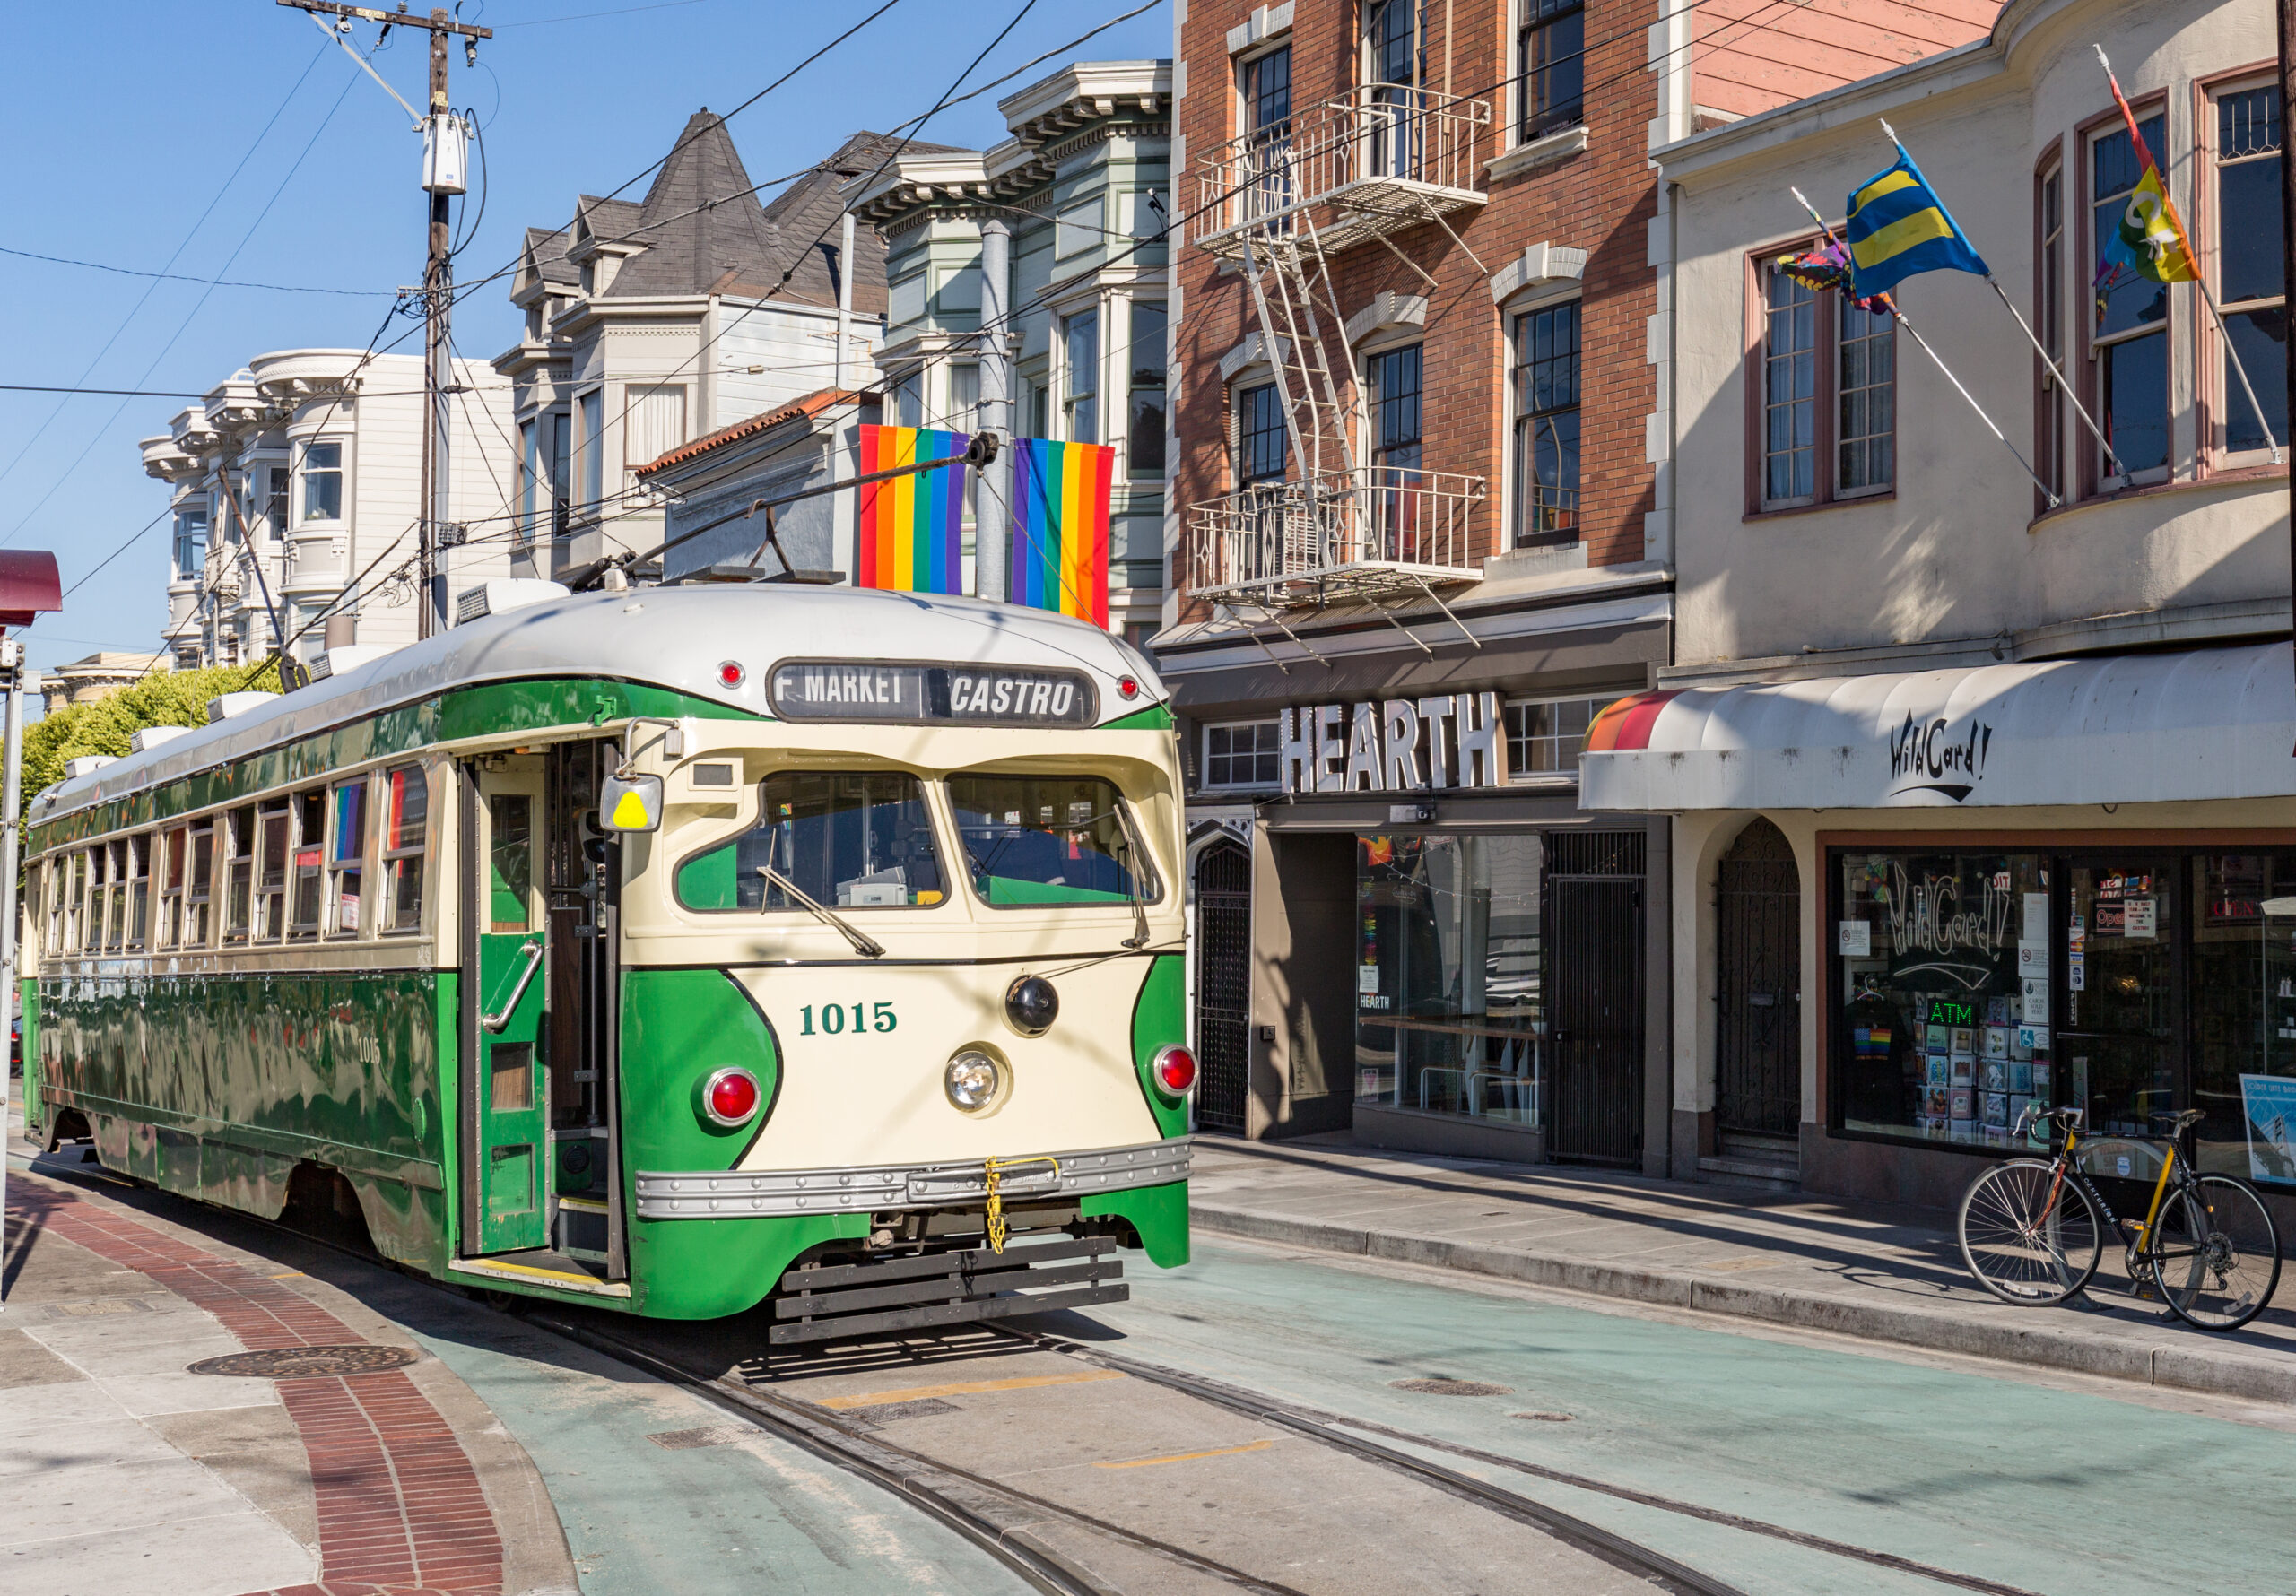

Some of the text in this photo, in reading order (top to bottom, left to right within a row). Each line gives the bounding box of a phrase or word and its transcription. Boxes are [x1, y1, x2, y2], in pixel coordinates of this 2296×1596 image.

[805, 667, 903, 703] MARKET
[951, 676, 1074, 716] CASTRO
[1280, 691, 1504, 793] HEARTH
[800, 1002, 897, 1036] 1015
[1360, 994, 1390, 1010] HEARTH
[1930, 1002, 1972, 1025] ATM
[359, 1037, 380, 1064] 1015
